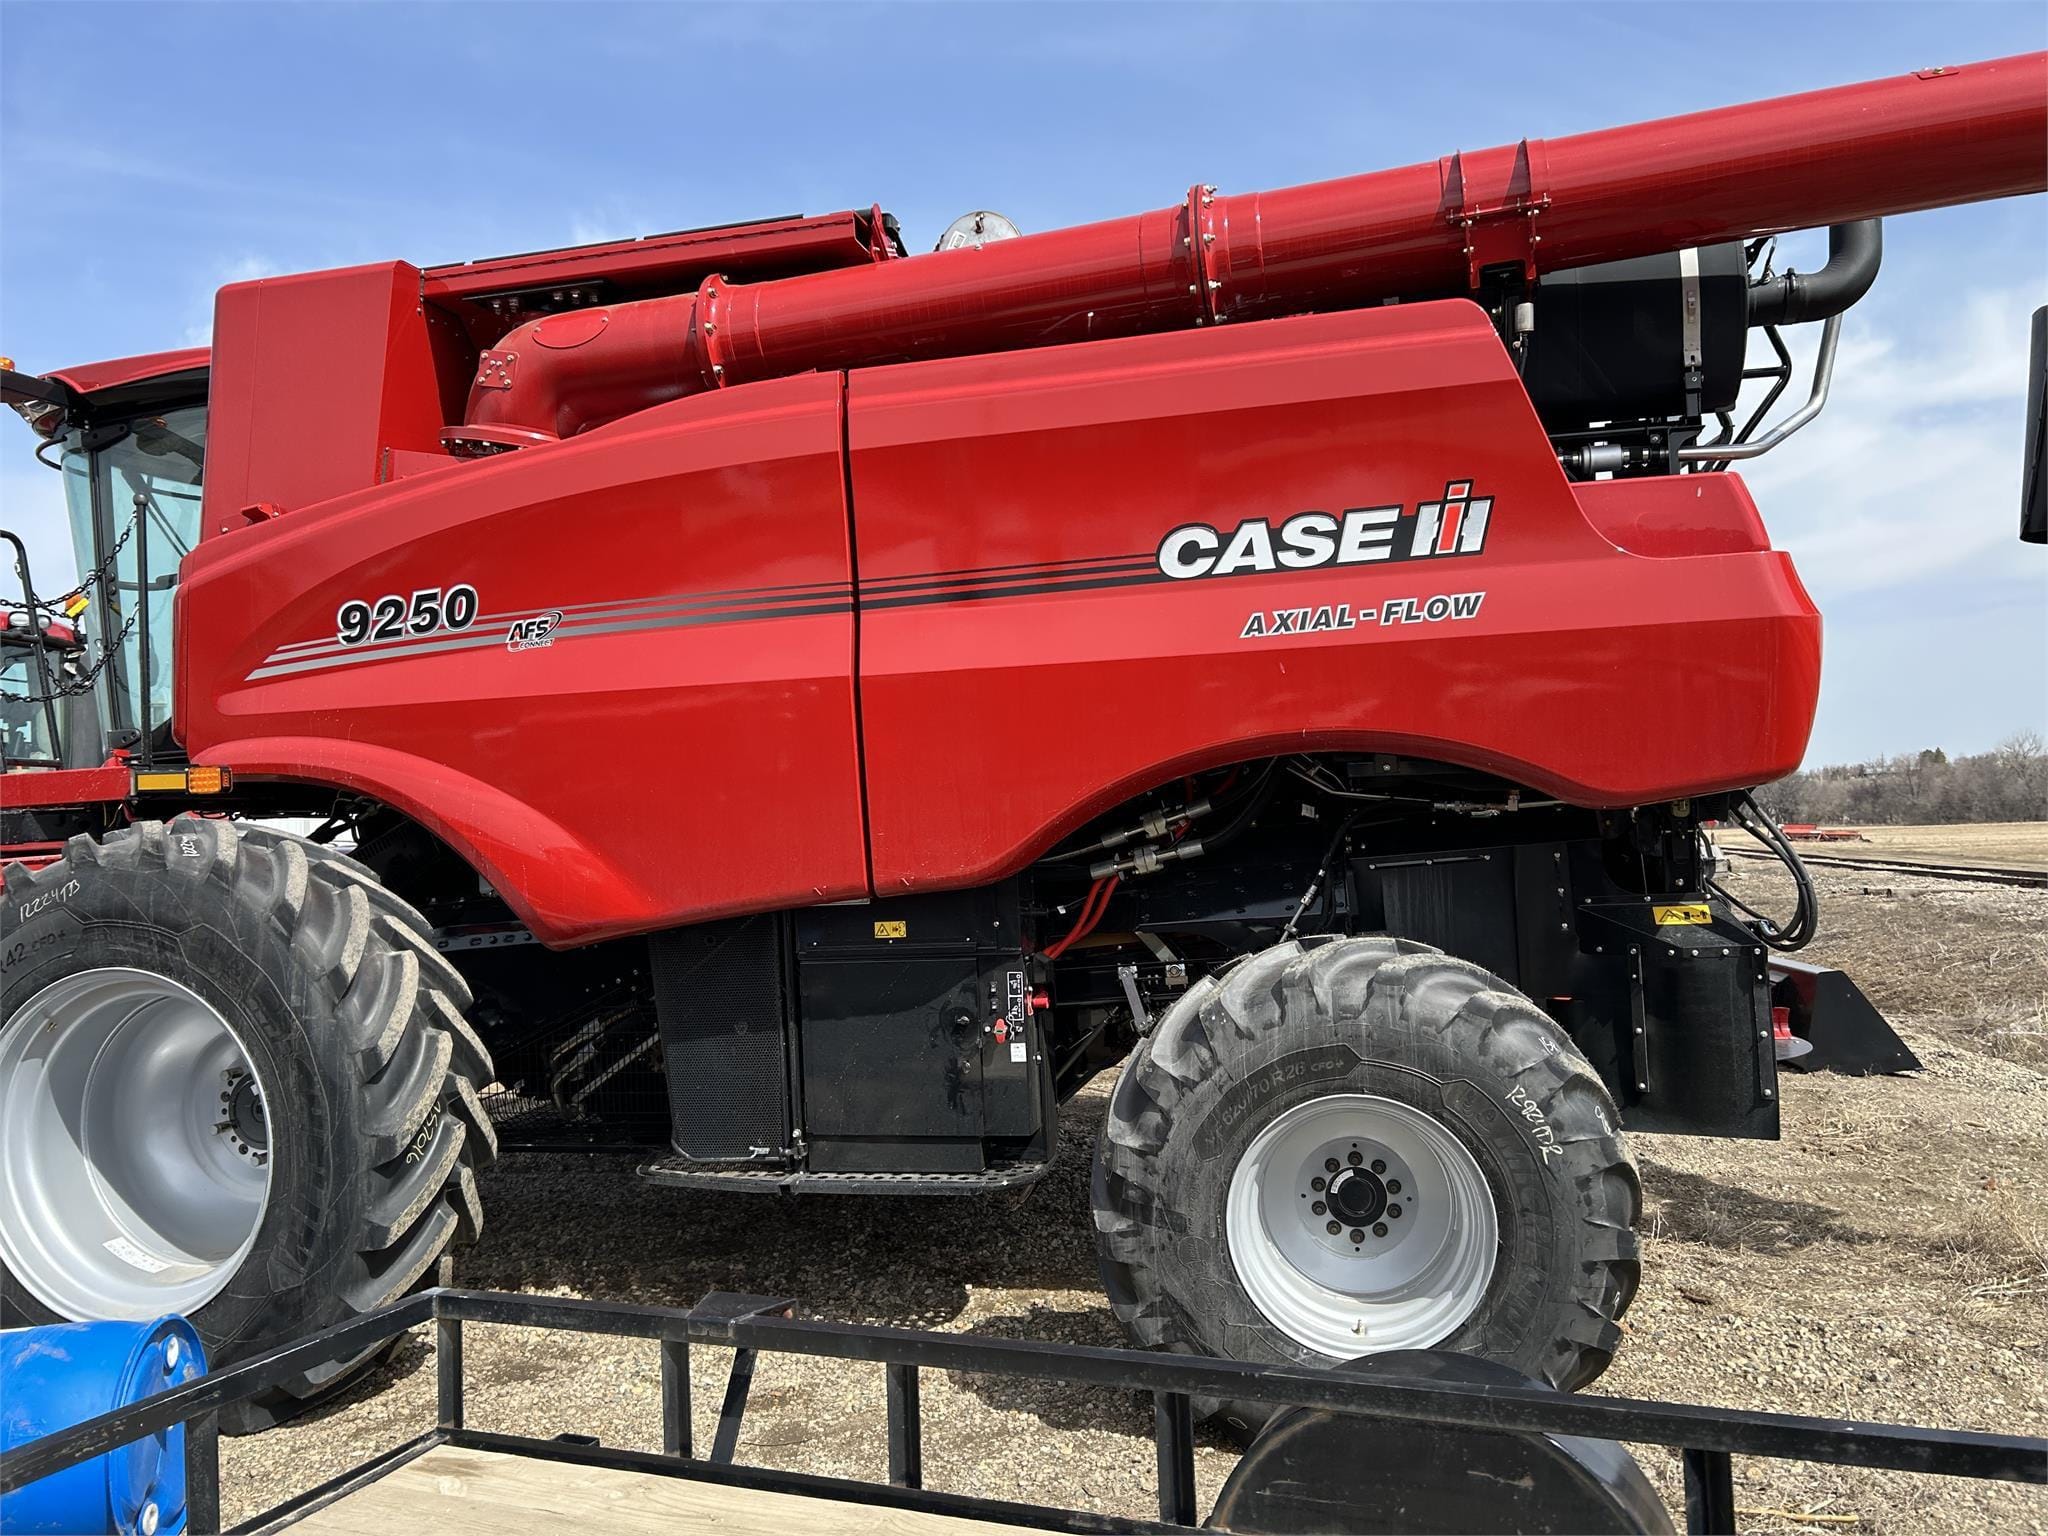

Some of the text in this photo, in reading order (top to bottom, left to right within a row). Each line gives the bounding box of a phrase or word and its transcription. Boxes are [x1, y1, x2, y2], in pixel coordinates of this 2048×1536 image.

[1157, 505, 1402, 581] CASE
[336, 583, 479, 649] 9250
[507, 617, 551, 642] AFS
[519, 639, 555, 649] CONNECT
